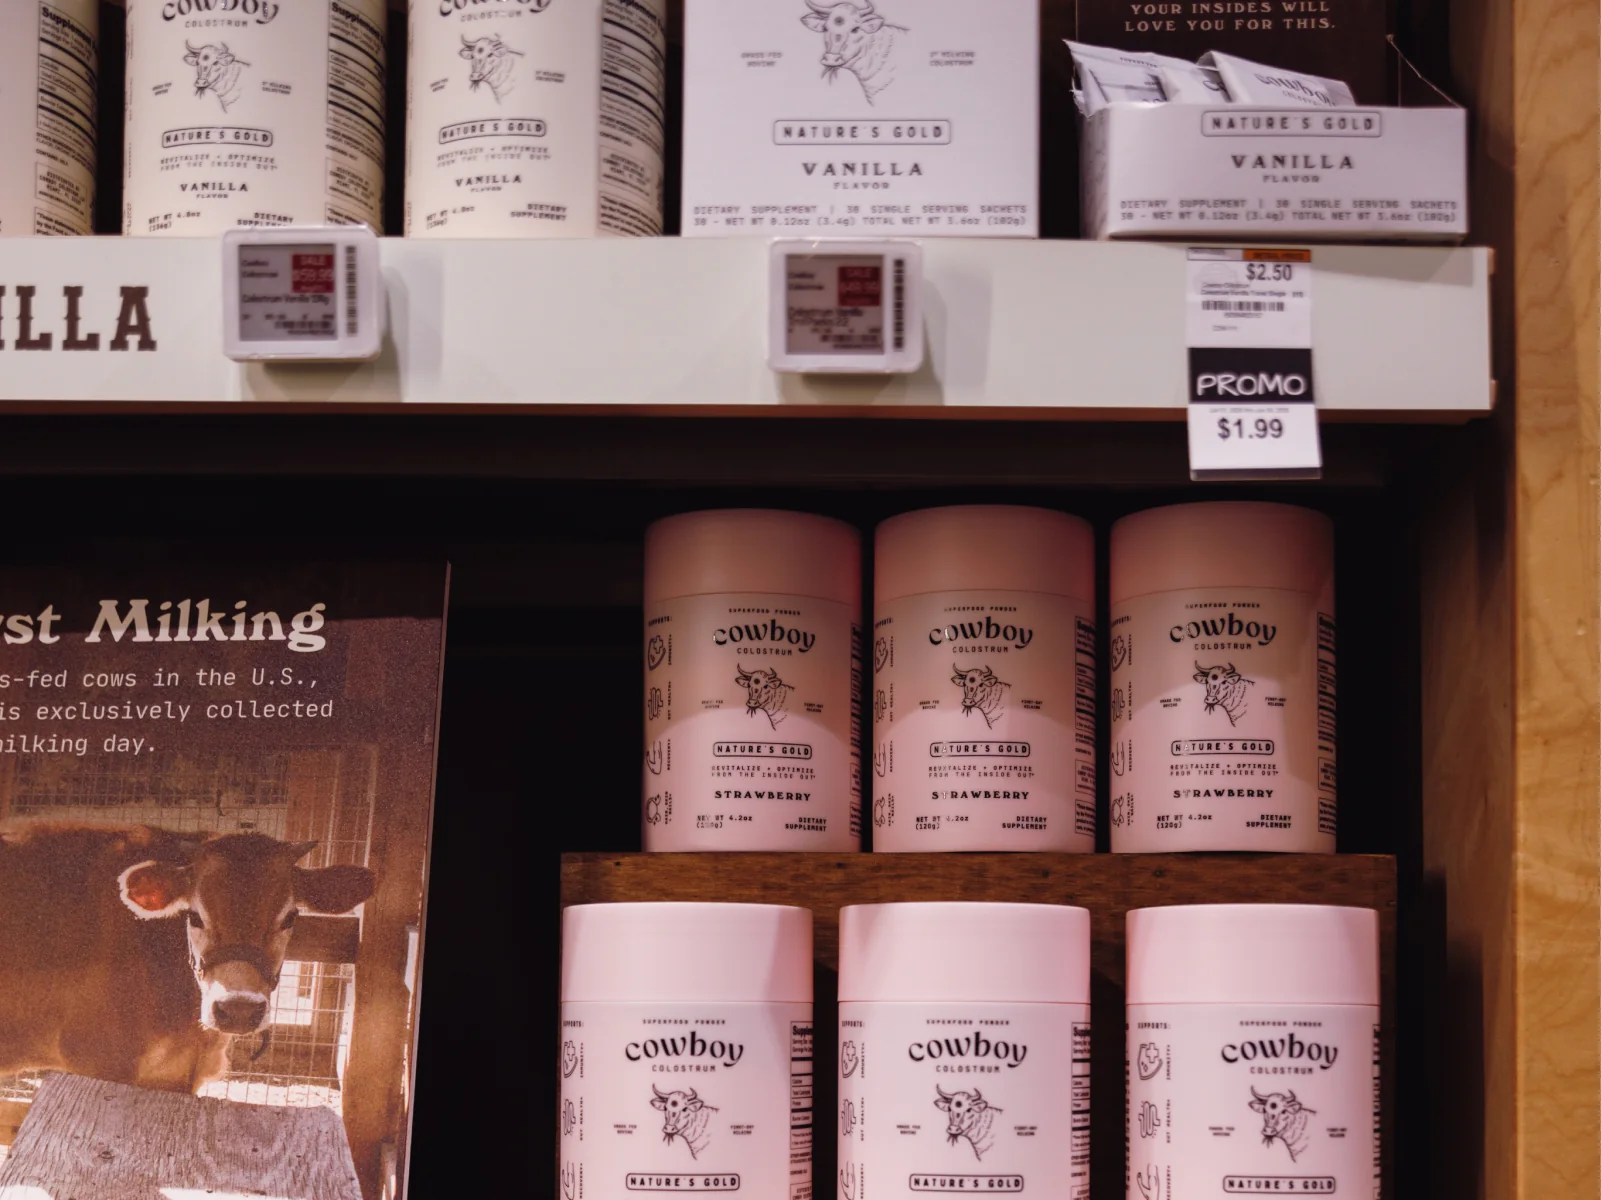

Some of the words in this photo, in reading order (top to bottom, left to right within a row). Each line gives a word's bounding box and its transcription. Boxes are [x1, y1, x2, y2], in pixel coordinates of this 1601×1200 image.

[1131, 4, 1183, 15] YOUR
[1192, 2, 1272, 13] INSIDES
[1283, 1, 1330, 12] WILL
[185, 20, 248, 28] COLOSTRUM
[1125, 20, 1176, 32] LOVE
[1187, 20, 1225, 31] YOU
[1235, 20, 1272, 30] FOR
[1283, 18, 1336, 29] THIS.
[507, 123, 543, 132] GOLD
[1324, 117, 1374, 131] GOLD
[234, 131, 269, 143] GOLD
[893, 126, 943, 138] GOLD
[1231, 155, 1355, 169] VANILLA
[801, 162, 924, 176] VANILLA
[456, 174, 522, 187] VANILLA
[1262, 175, 1321, 183] FLAVOR
[180, 183, 248, 192] VANILLA
[833, 182, 890, 190] FLAVOR
[694, 206, 741, 214] DIETARY
[751, 205, 817, 214] SUPPLEMENT
[871, 205, 911, 214] SINGLE
[922, 205, 969, 214] SERVING
[979, 205, 1027, 214] SACHETS
[1121, 200, 1168, 210] DIETARY
[1179, 199, 1246, 209] SUPPLEMENT
[1300, 199, 1341, 209] SINGLE
[1352, 200, 1399, 209] SERVING
[1410, 200, 1457, 210] SACHETS
[254, 212, 294, 224] DIETARY
[863, 217, 895, 225] TOTAL
[1247, 263, 1292, 281] $2.50
[1196, 372, 1305, 396] PROMO
[1217, 417, 1283, 441] $1.99
[84, 598, 326, 652] Milking
[1169, 613, 1277, 646] cowboy
[713, 619, 816, 653] cowboy
[929, 616, 1033, 649] cowboy
[737, 647, 793, 656] COLOSTRUM
[1194, 642, 1252, 650] COLOSTRUM
[82, 671, 137, 687] cows
[153, 669, 180, 687] in
[196, 669, 236, 686] the
[251, 667, 319, 689] U.S.,
[36, 701, 190, 724] exclusively
[206, 700, 333, 718] collected
[103, 735, 156, 755] day.
[998, 745, 1027, 753] GOLD
[1242, 743, 1271, 751] GOLD
[782, 746, 810, 756] GOLD
[714, 790, 811, 801] STRAWBERRY
[798, 817, 827, 825] DIETARY
[1002, 822, 1047, 830] SUPPLEMENT
[1246, 821, 1292, 829] SUPPLEMENT
[785, 824, 827, 832] SUPPLEMENT
[625, 1031, 745, 1067] cowboy
[908, 1031, 1028, 1068] cowboy
[1221, 1033, 1338, 1071] cowboy
[936, 1065, 1000, 1073] COLOSTRUM
[1250, 1067, 1314, 1075] COLOSTRUM
[704, 1177, 737, 1187] GOLD
[988, 1179, 1020, 1188] GOLD
[1303, 1180, 1333, 1190] GOLD
